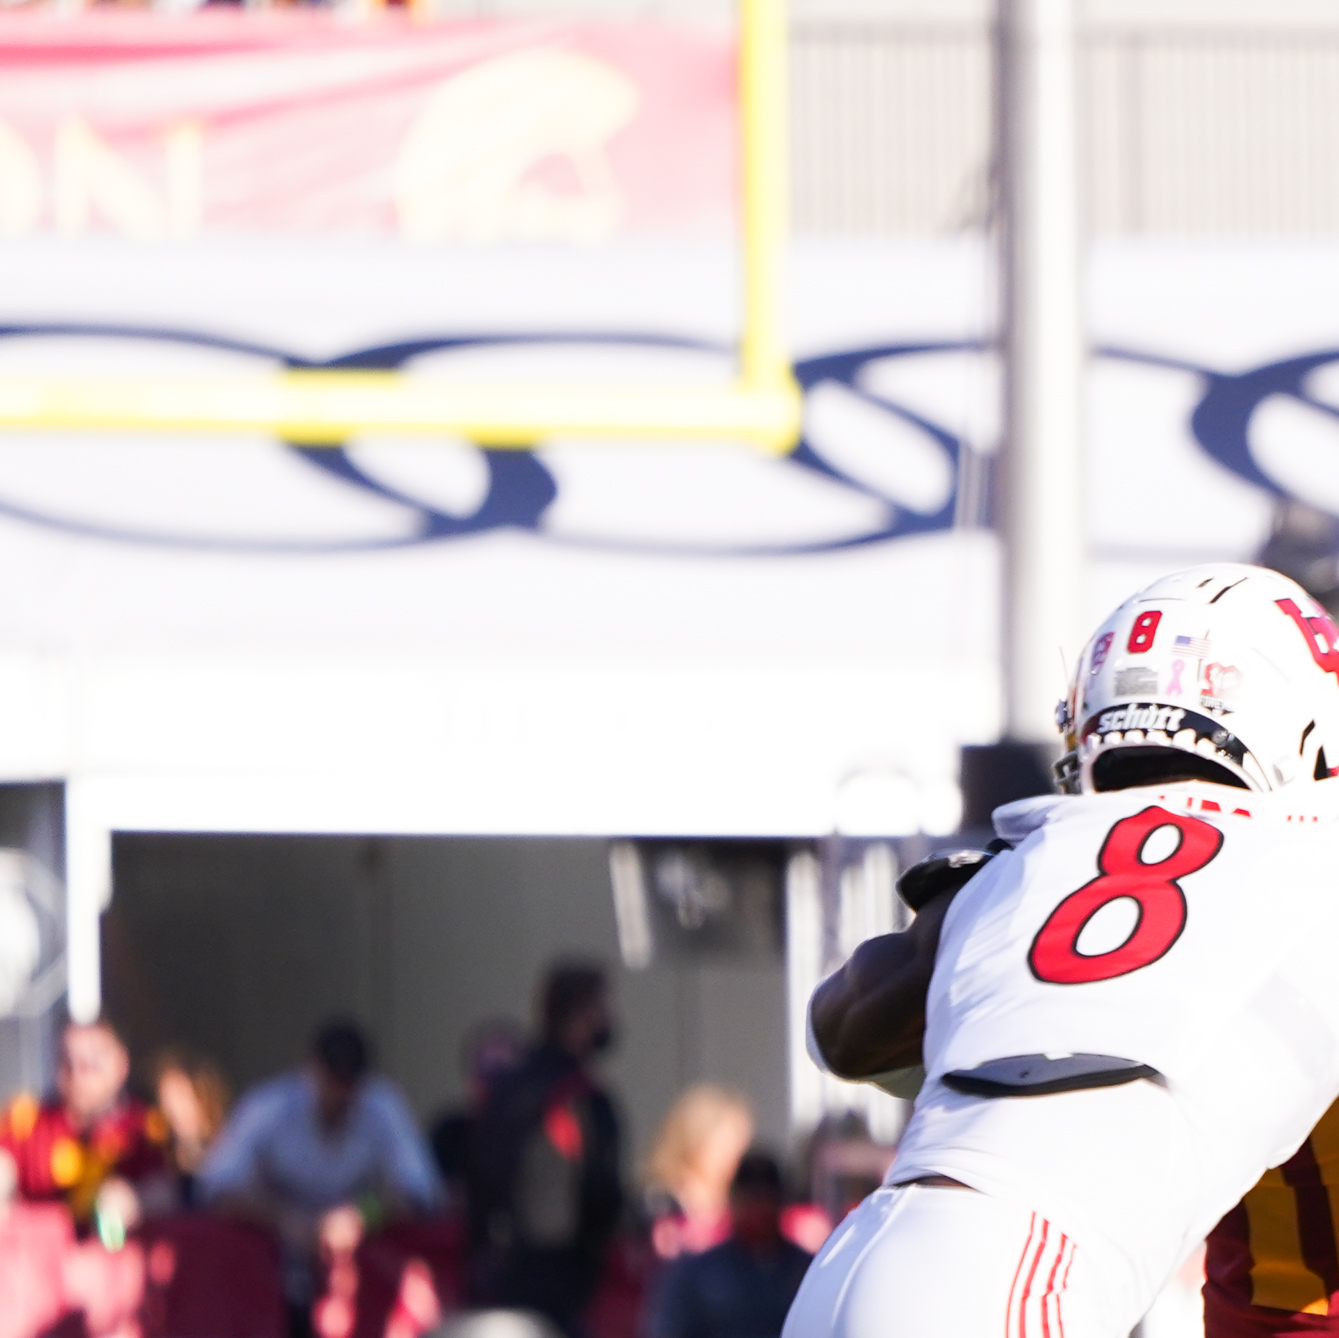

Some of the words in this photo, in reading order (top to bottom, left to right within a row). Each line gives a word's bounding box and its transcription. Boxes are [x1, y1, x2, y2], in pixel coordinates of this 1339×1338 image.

[1127, 610, 1163, 654] 8
[1098, 703, 1186, 733] schutt
[1028, 806, 1224, 984] 8
